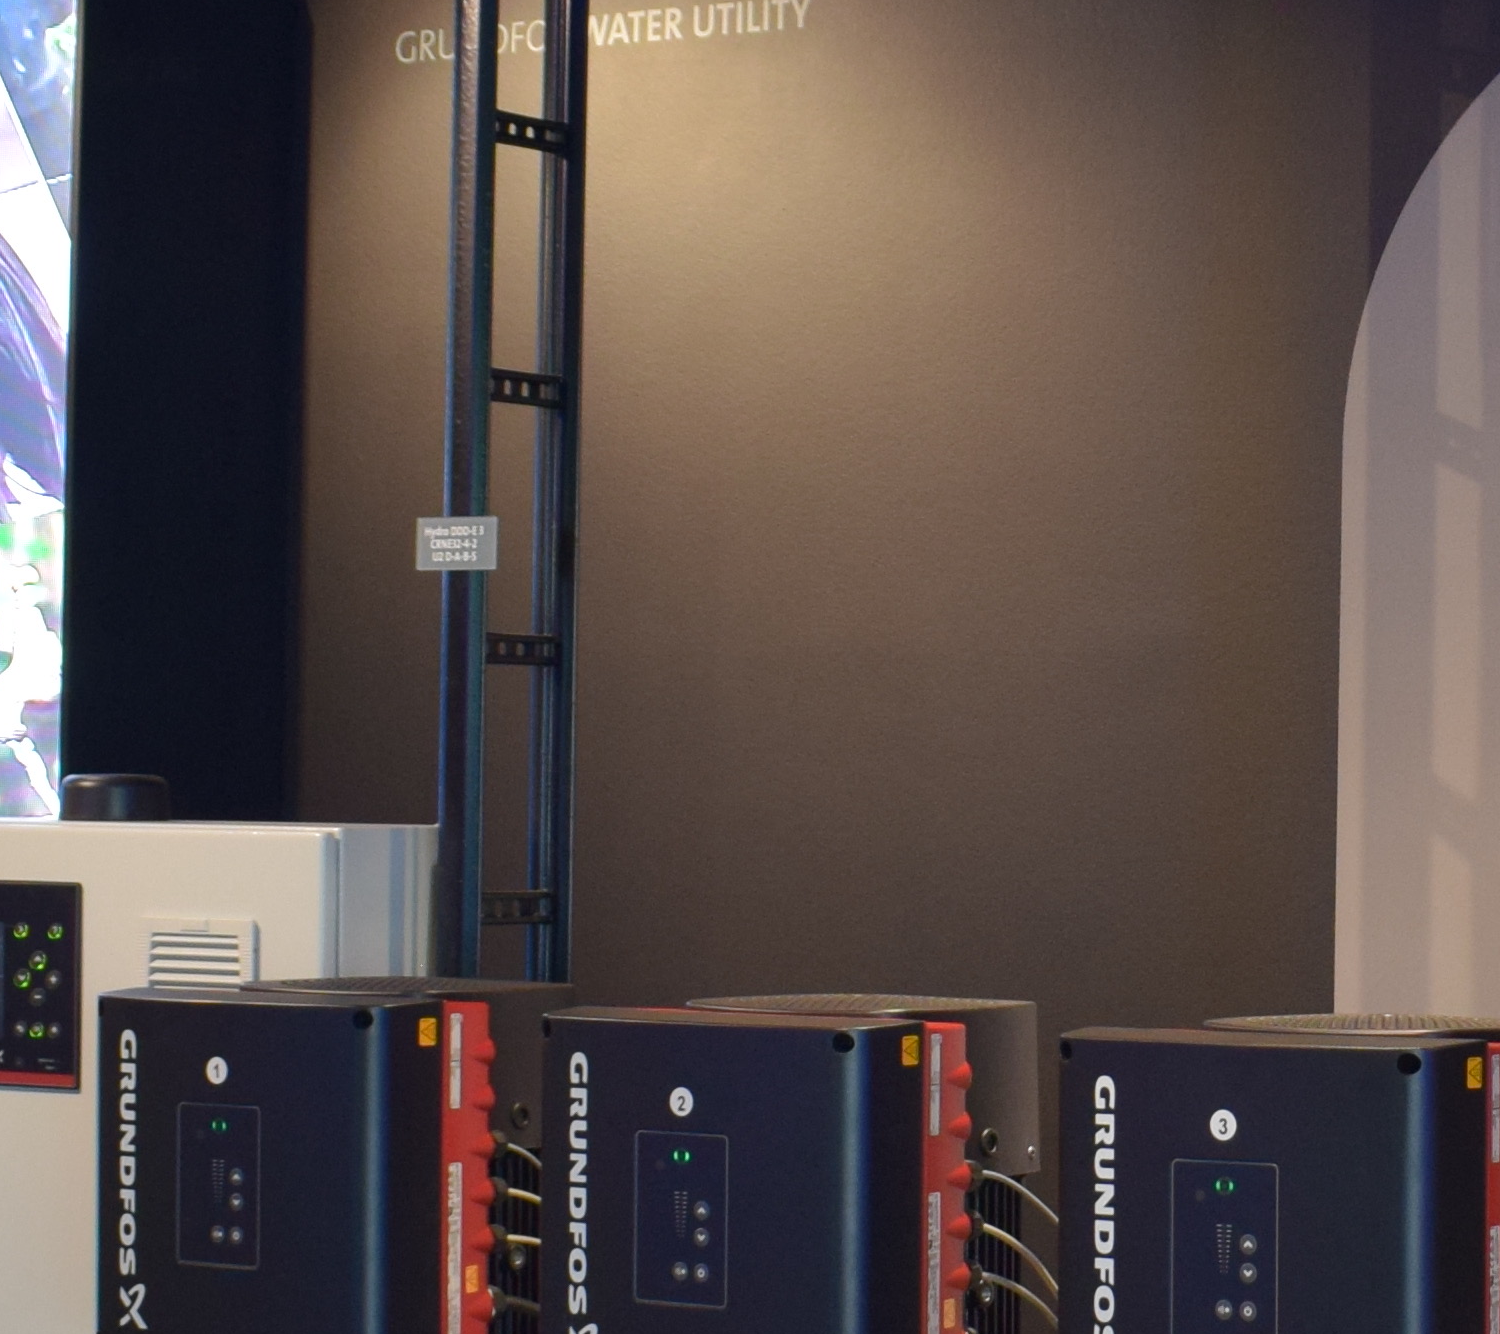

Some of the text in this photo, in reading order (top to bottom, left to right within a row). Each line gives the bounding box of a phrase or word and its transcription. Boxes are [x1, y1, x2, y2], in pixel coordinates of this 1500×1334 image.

[395, 19, 546, 64] GRUDFO
[212, 1063, 221, 1078] 1
[677, 1094, 687, 1112] 2
[1218, 1117, 1229, 1135] 3
[118, 1029, 138, 1276] GRUNDFOS
[568, 1051, 589, 1315] GRUNDFOS
